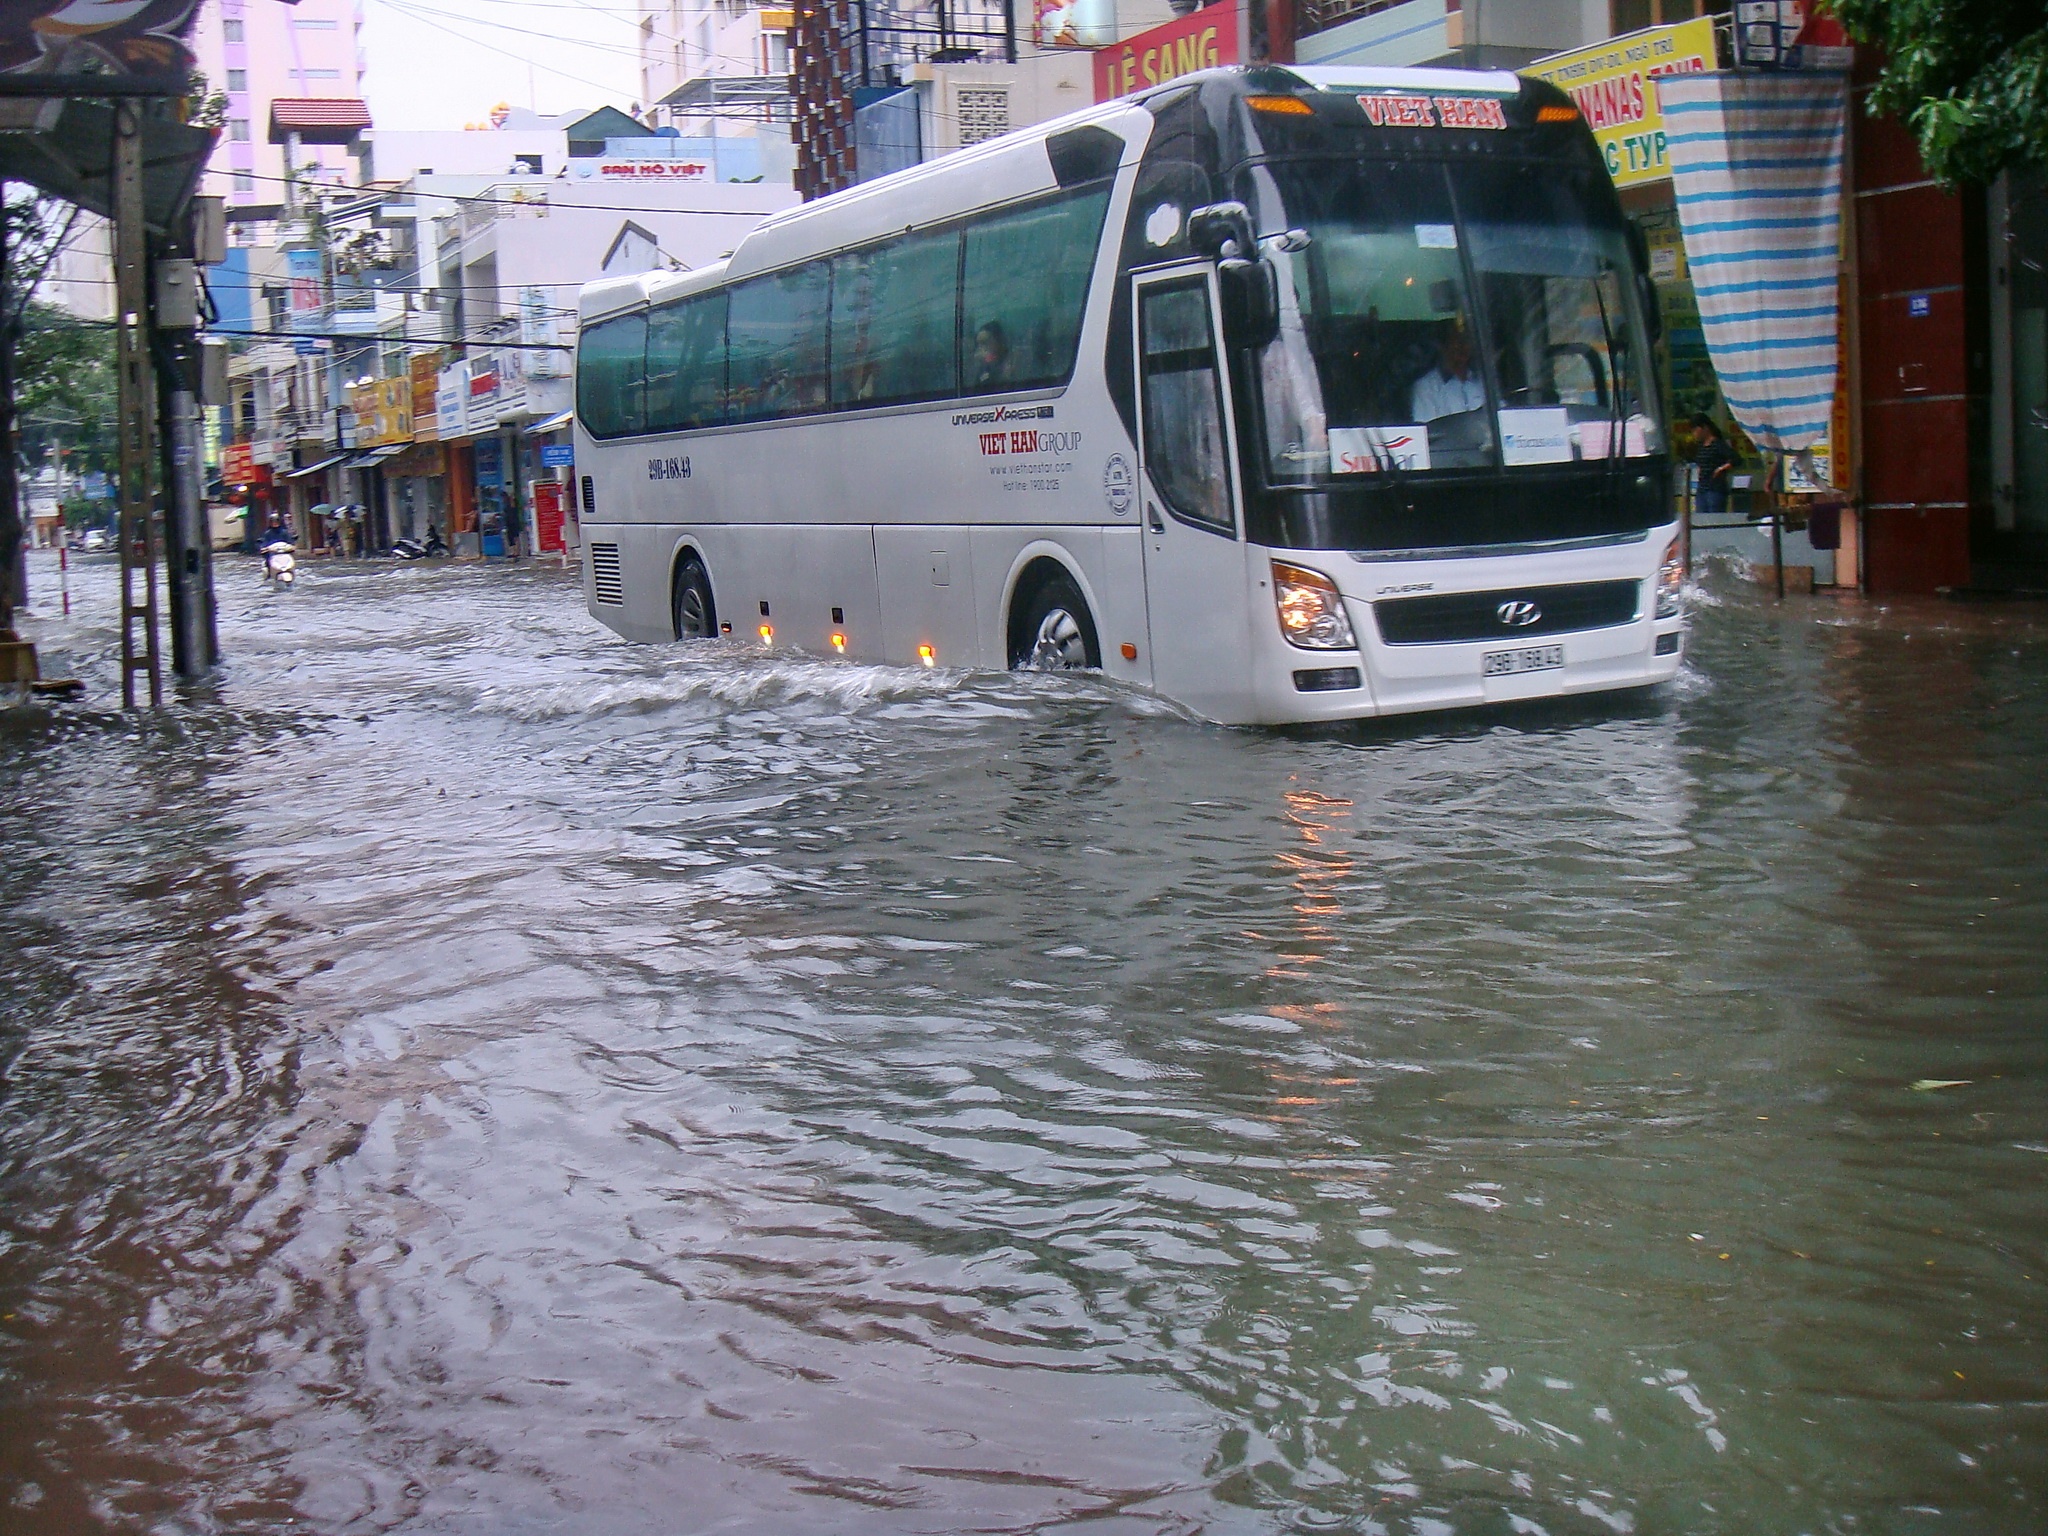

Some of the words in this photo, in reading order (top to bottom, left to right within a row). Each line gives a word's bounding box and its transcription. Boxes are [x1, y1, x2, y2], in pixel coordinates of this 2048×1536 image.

[1142, 26, 1219, 85] SANG
[1355, 95, 1436, 126] VIET
[1432, 96, 1508, 130] HAN
[1567, 70, 1644, 131] NANAS
[979, 432, 1007, 455] VIET
